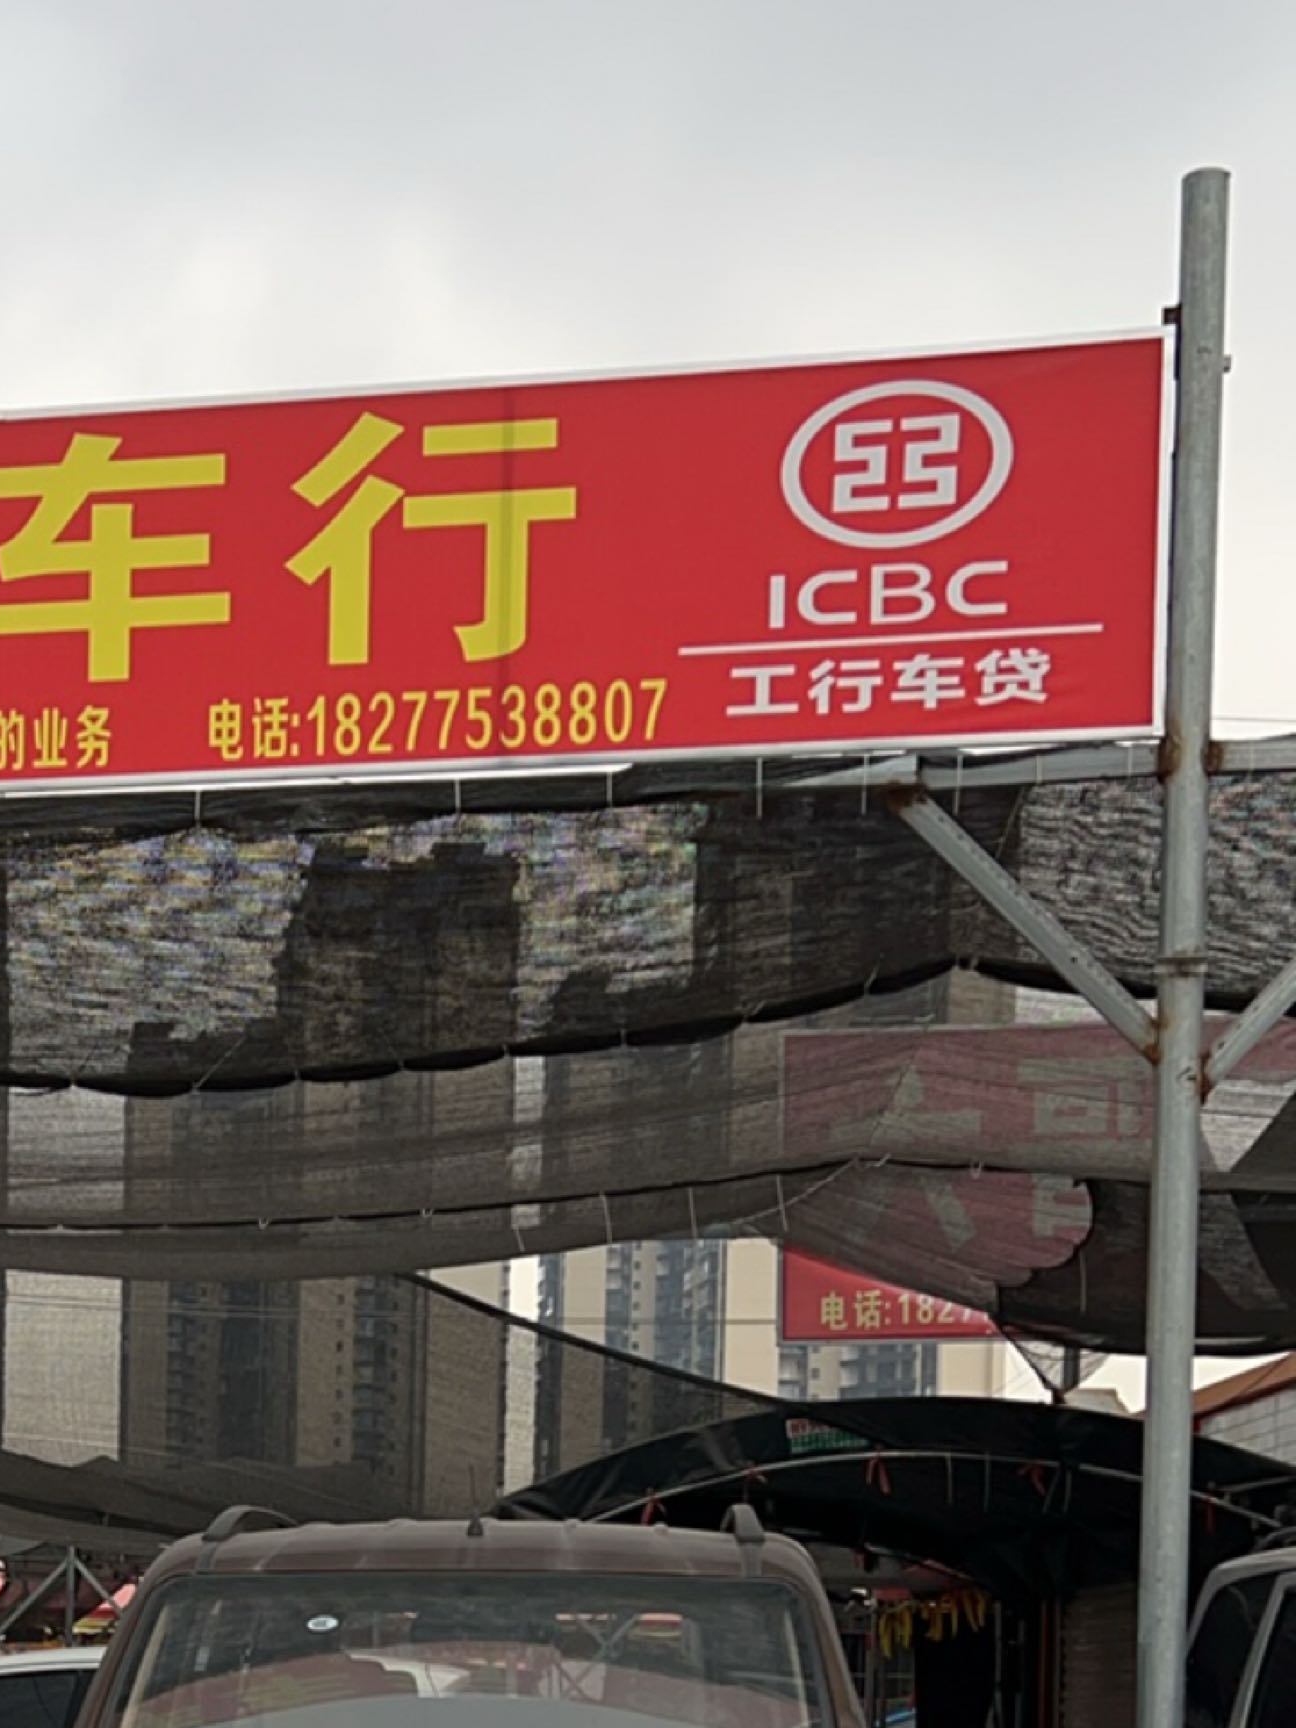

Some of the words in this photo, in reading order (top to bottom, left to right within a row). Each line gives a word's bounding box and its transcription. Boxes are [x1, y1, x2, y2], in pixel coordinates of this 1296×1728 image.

[768, 559, 1010, 630] ICBC
[725, 648, 1051, 718] 工行车贷
[207, 678, 668, 762] 电话:18277538807
